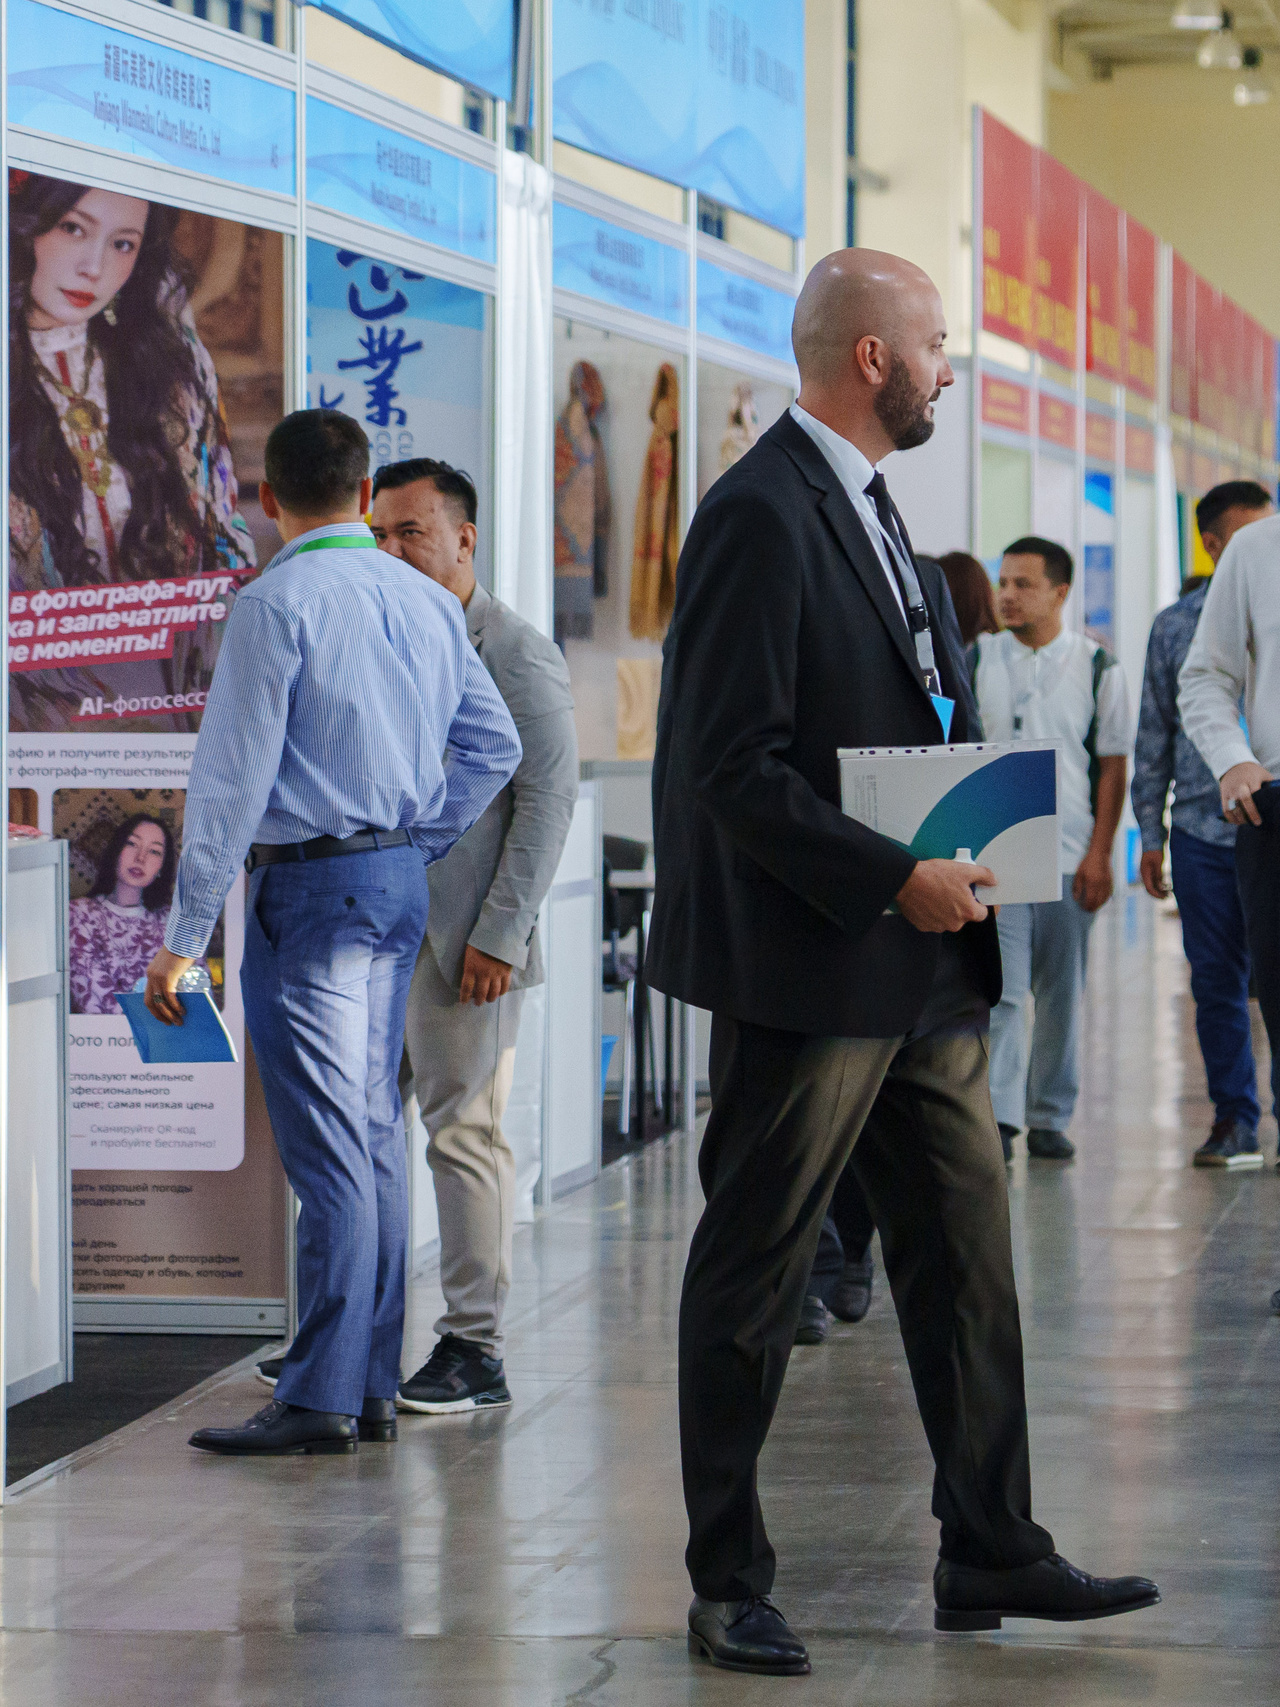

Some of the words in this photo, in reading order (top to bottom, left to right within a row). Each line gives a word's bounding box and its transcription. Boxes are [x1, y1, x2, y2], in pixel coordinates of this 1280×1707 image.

[10, 595, 28, 615] в
[30, 576, 233, 617] фотографа-пут
[36, 617, 57, 637] и
[58, 601, 226, 635] запечатлите
[31, 628, 169, 662] моменты!
[79, 691, 209, 717] AI-фотосесс
[48, 750, 56, 759] и
[60, 749, 120, 762] получите
[131, 1071, 194, 1082] мобильное
[107, 1100, 142, 1110] самая
[144, 1101, 184, 1110] низкая
[186, 1101, 215, 1111] цена
[90, 1122, 155, 1136] Сканируйте
[101, 1137, 151, 1150] пробуйте
